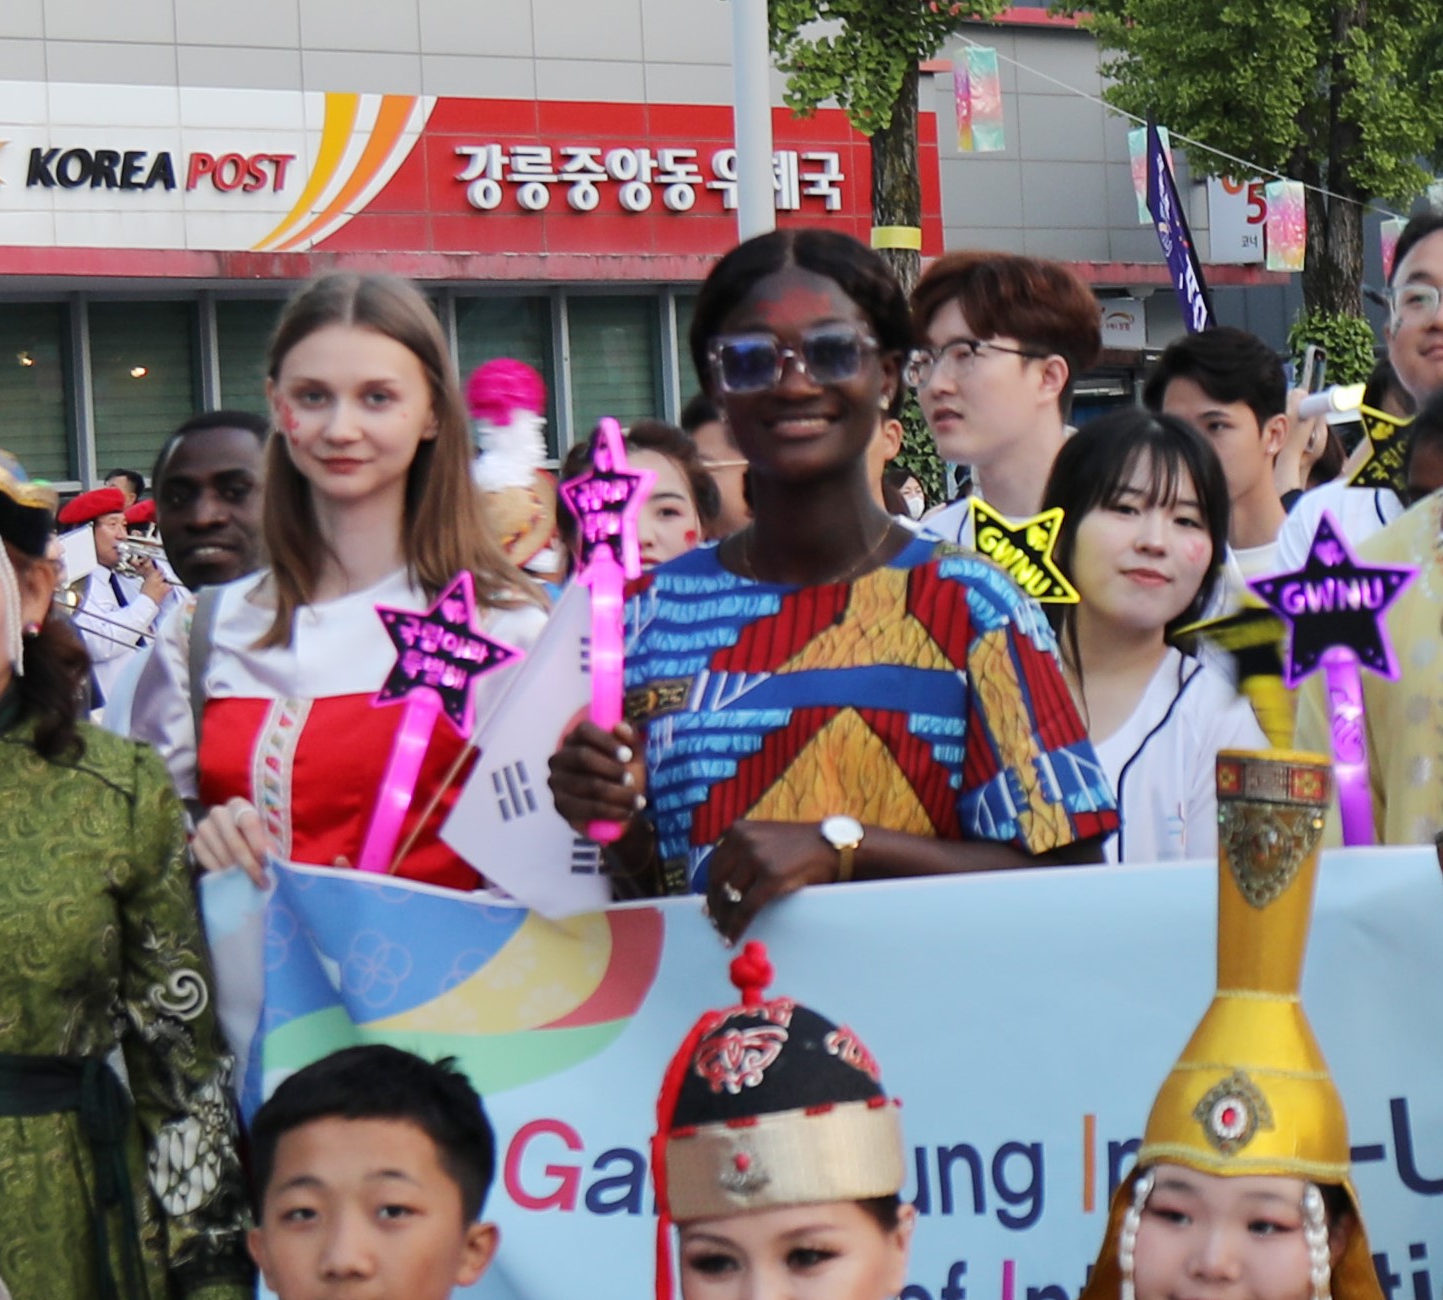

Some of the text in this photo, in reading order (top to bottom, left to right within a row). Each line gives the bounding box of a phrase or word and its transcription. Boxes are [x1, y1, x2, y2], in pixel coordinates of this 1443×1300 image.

[26, 147, 297, 192] KOREA POST
[977, 525, 1053, 598] GWNU
[1280, 576, 1385, 613] GWNU
